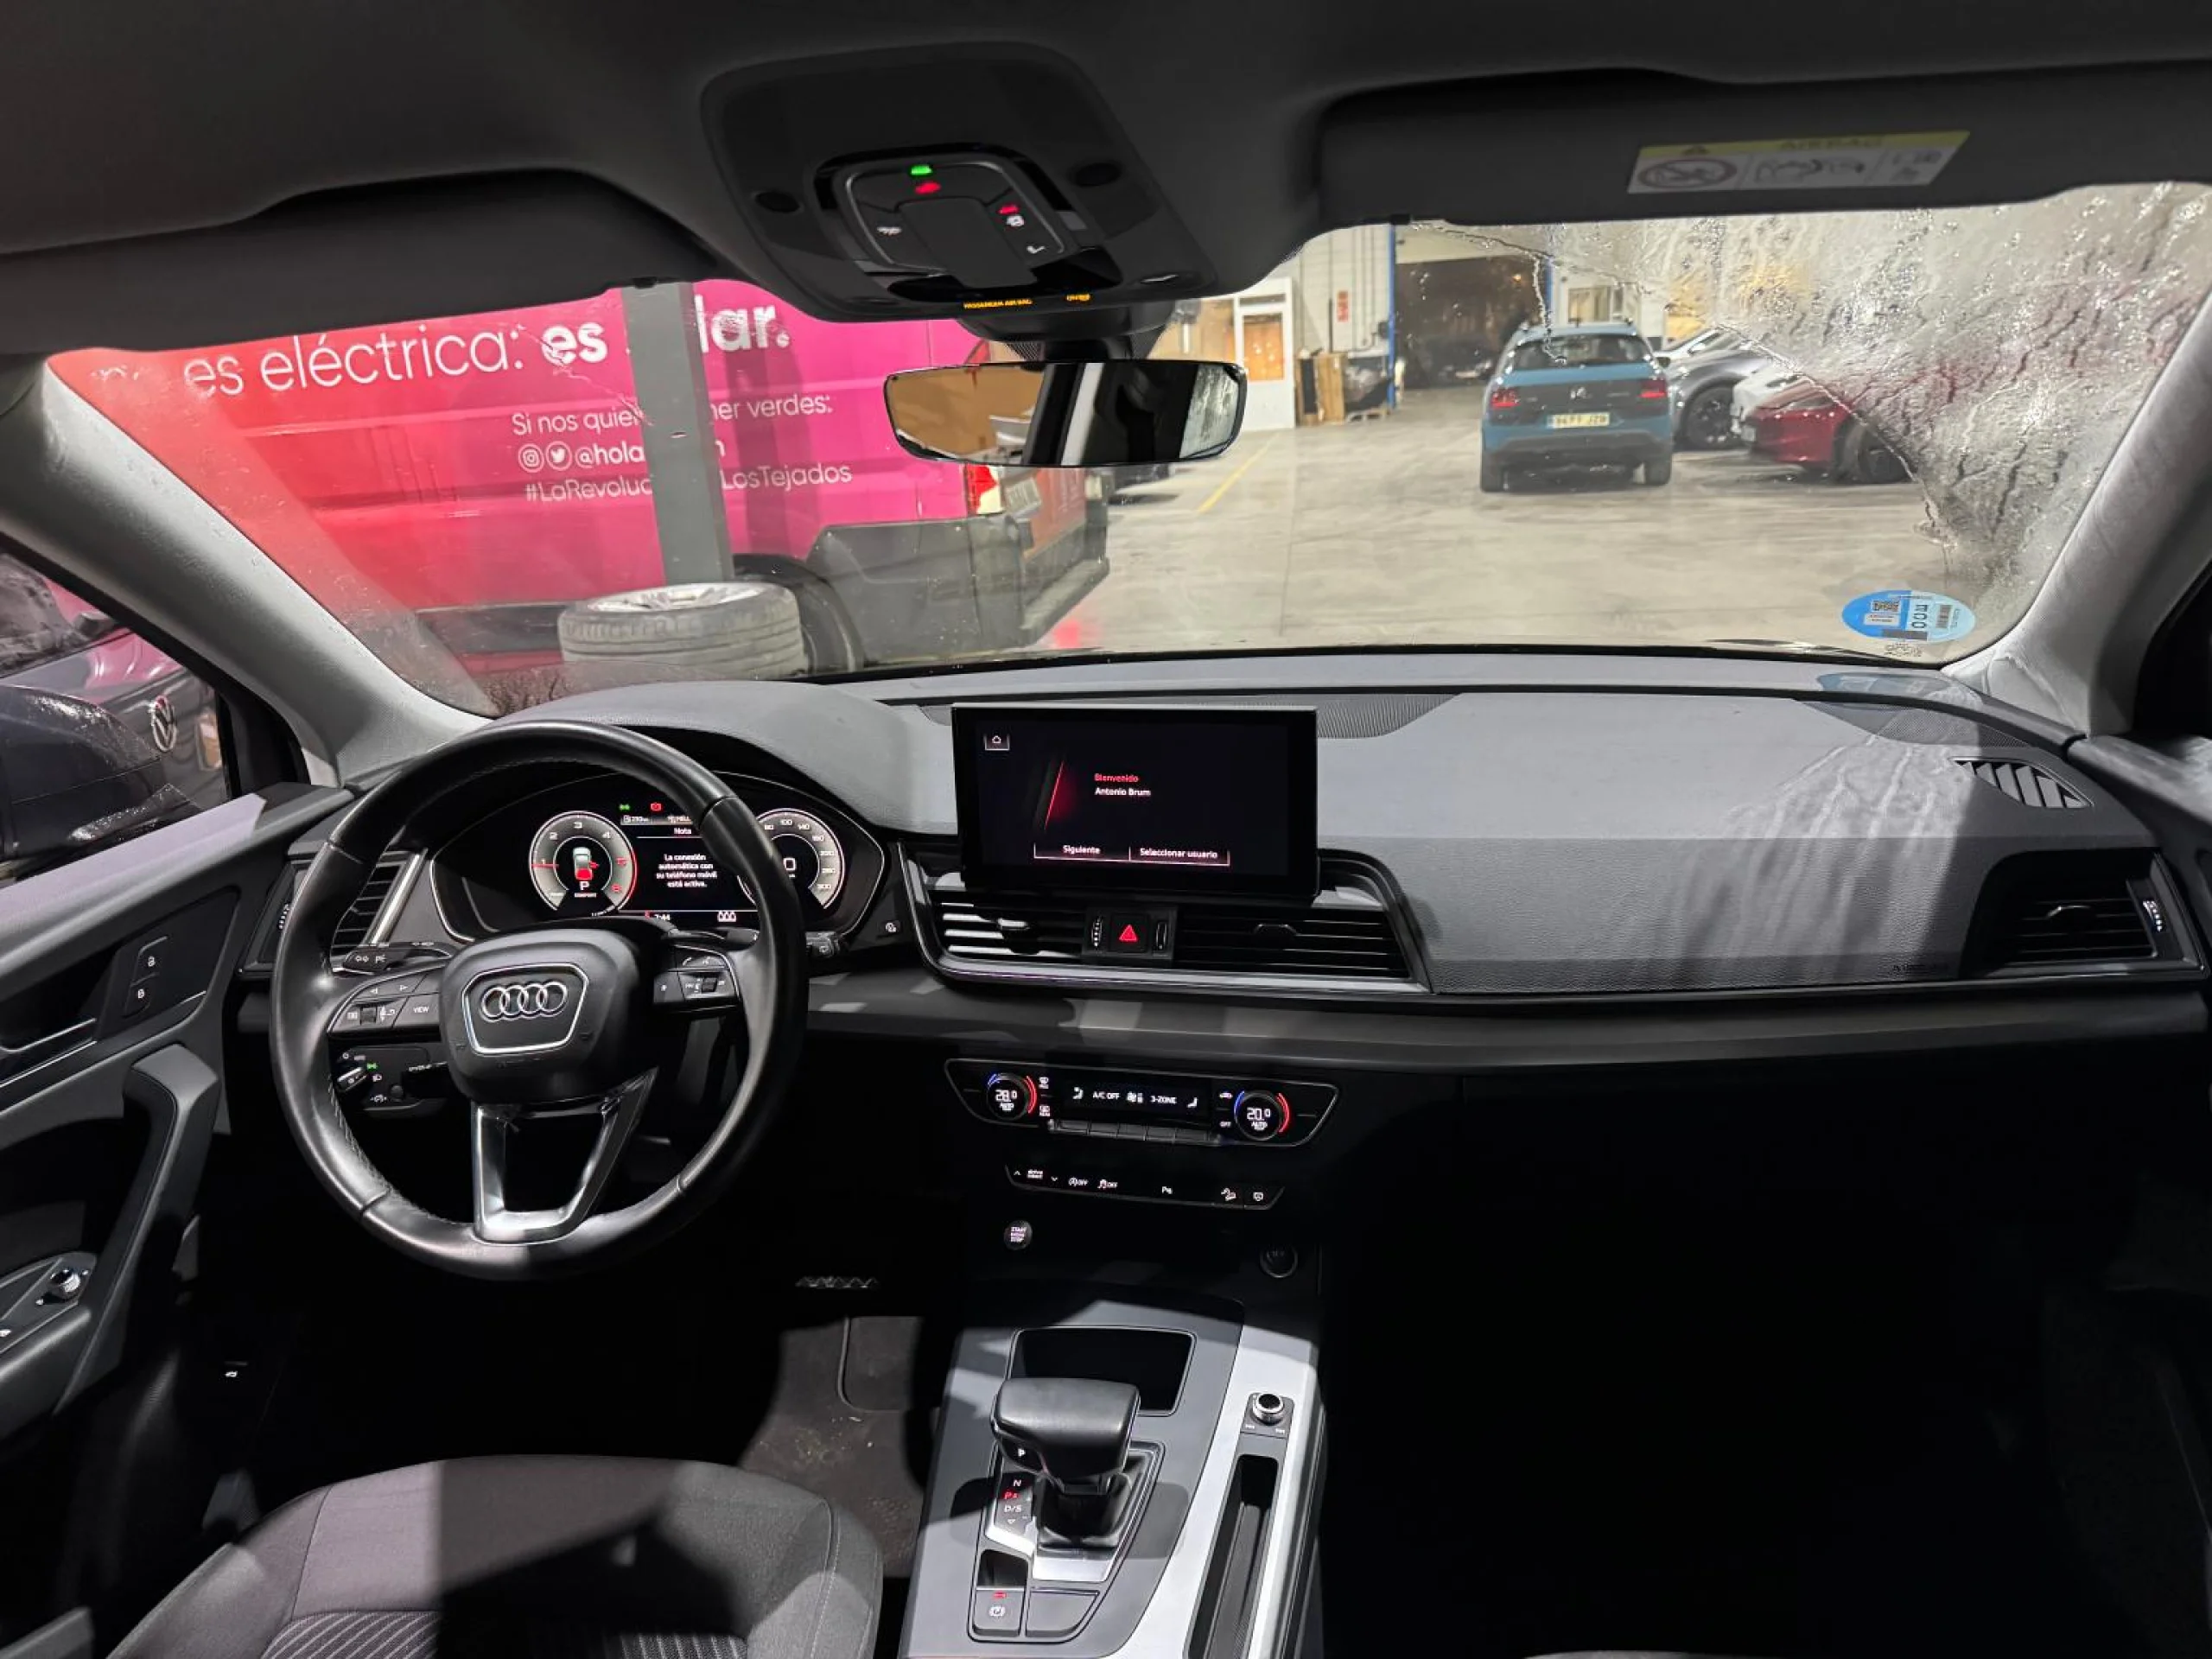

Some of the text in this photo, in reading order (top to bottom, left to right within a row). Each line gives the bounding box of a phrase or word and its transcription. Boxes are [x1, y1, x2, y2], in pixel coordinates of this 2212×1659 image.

[184, 294, 790, 397] es eléctrica: es lar.
[512, 411, 532, 435] Si
[537, 414, 580, 435] nos
[582, 406, 643, 435] quier
[747, 393, 832, 419] verdes:
[575, 441, 646, 468] @hola
[720, 463, 853, 493] LosTejados
[1094, 772, 1139, 783] Bienvenido
[1094, 787, 1151, 797] Antonio Brum
[550, 831, 558, 840] 2
[1063, 844, 1101, 855] Siguiente
[1140, 848, 1186, 858] Seleccionar
[665, 870, 696, 879] teléfono
[580, 881, 589, 891] P
[1018, 1448, 1026, 1457] P
[1014, 1478, 1022, 1487] N
[1004, 1504, 1022, 1513] D/S
